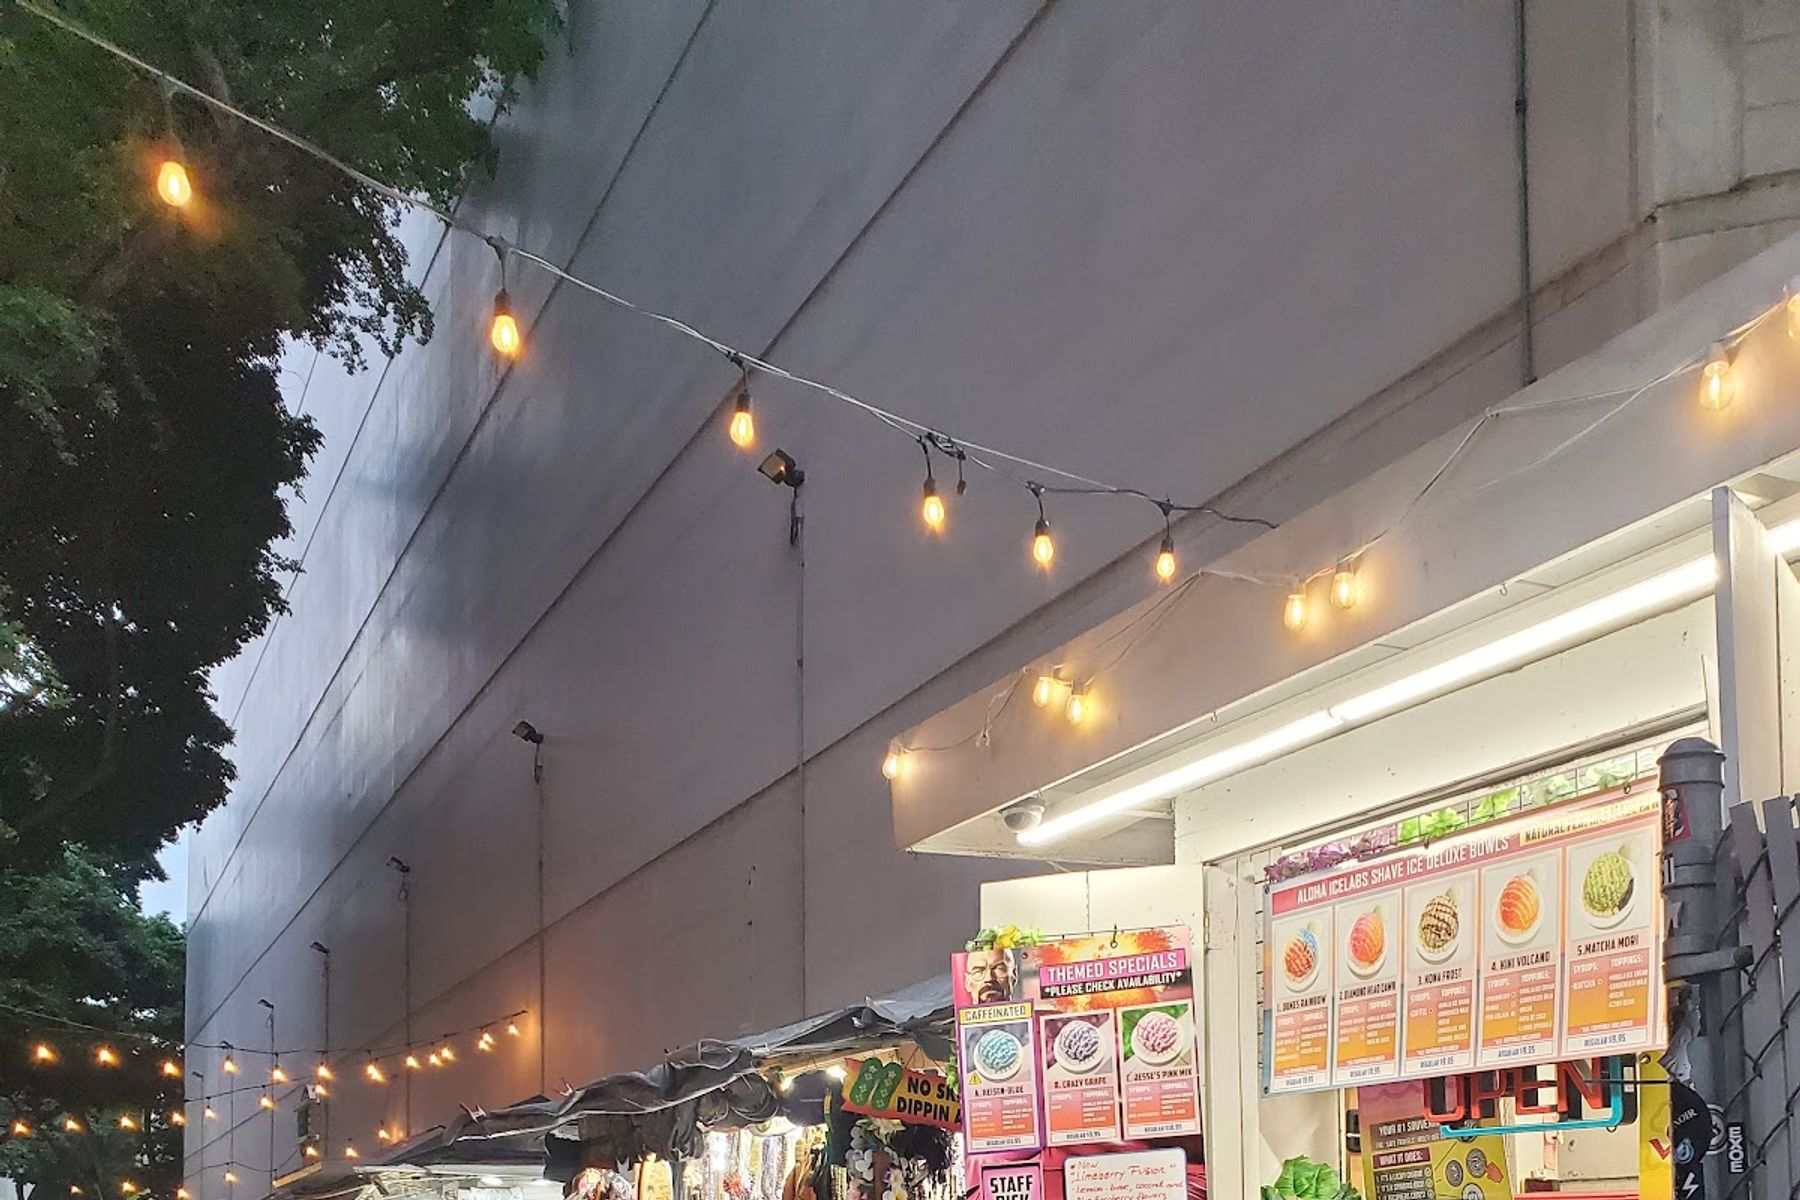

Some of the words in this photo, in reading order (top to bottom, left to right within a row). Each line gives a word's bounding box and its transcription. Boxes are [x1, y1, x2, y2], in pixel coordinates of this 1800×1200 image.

[1297, 889, 1327, 905] ALOHA
[1329, 872, 1368, 896] ICELABS
[1371, 858, 1404, 884] SHAVE
[1406, 856, 1424, 876] ICE
[1426, 845, 1467, 871] DELUXE
[1469, 835, 1509, 858] BOWLS
[1048, 964, 1104, 983] THEMED
[1109, 953, 1177, 975] SPECIALS
[1517, 951, 1551, 967] VOLCANO
[1085, 980, 1115, 993] CHECK
[965, 1005, 1027, 1021] CAFFEINATED
[1162, 1069, 1179, 1078] PINK
[907, 1076, 931, 1096] NO
[1062, 1079, 1083, 1089] CRAZY
[1424, 1057, 1603, 1122] OPEN
[897, 1097, 950, 1122] DIPPIN
[990, 1174, 1033, 1194] STAFF
